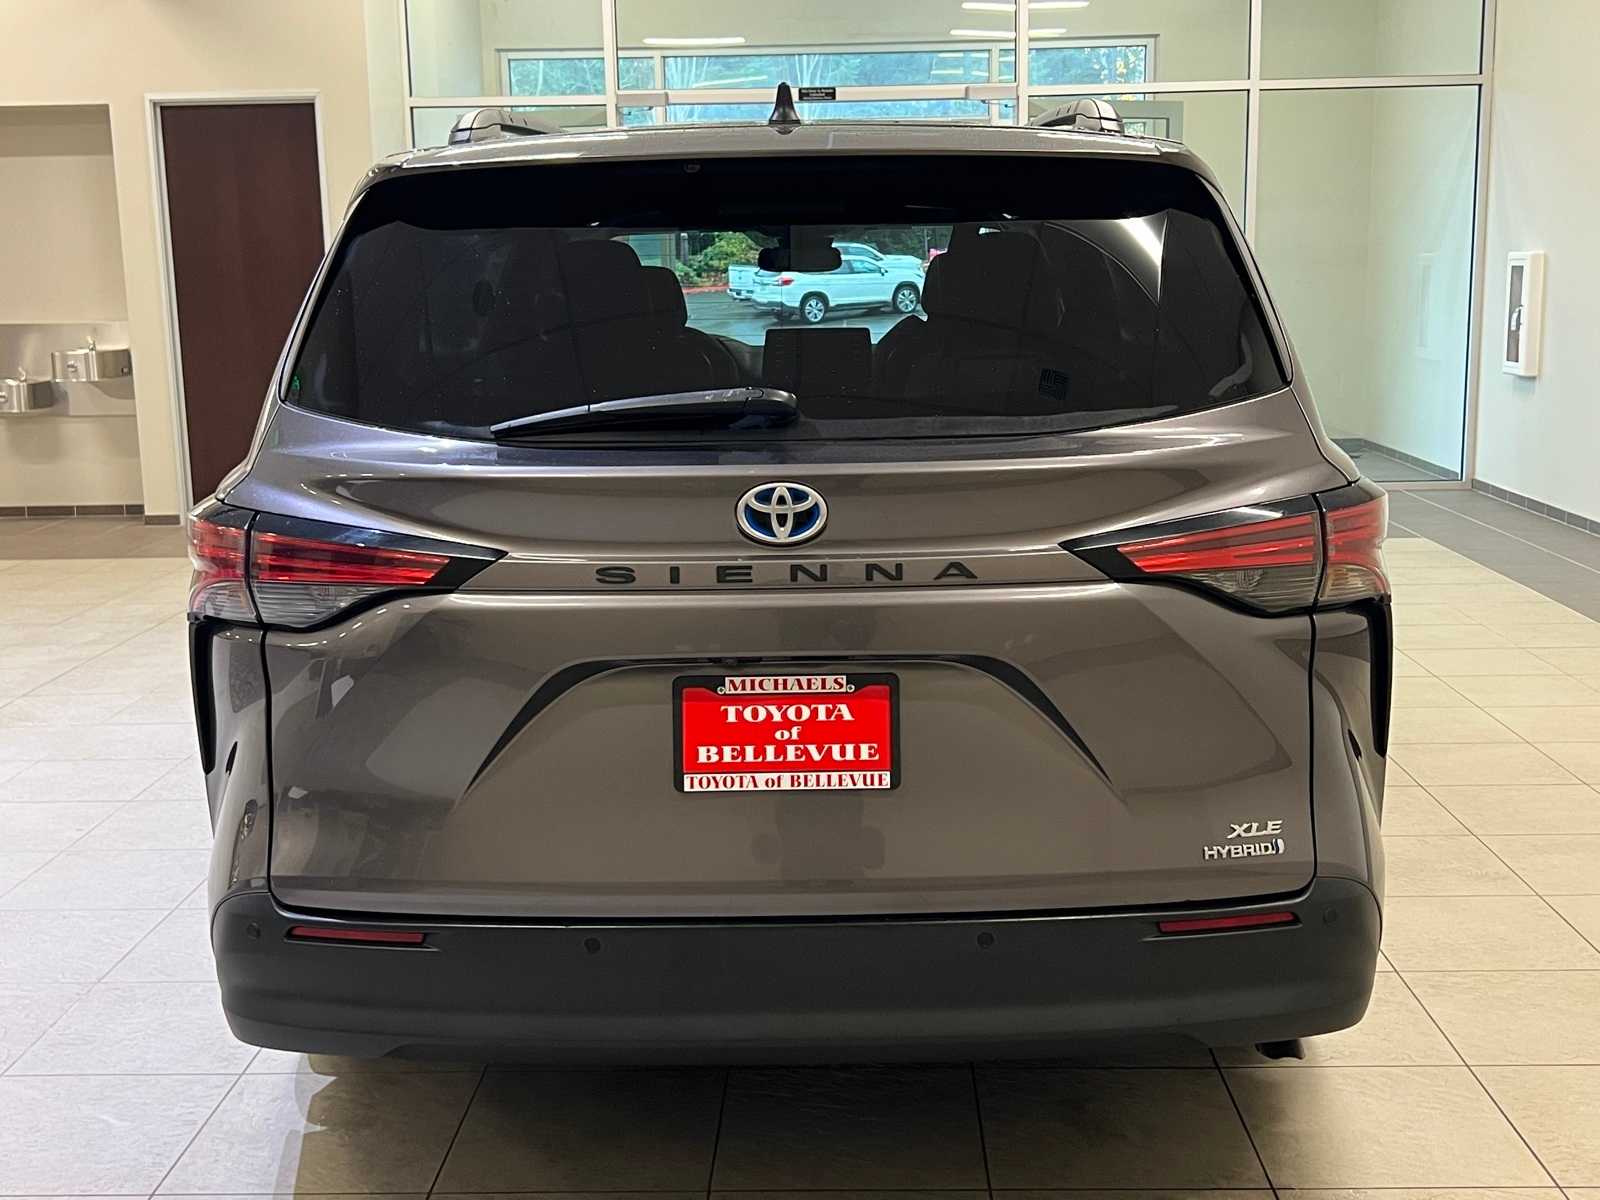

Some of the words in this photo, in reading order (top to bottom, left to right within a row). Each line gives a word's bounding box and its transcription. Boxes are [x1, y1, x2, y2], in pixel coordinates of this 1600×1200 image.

[595, 562, 978, 584] SIENNA
[727, 676, 845, 692] MICHAELS
[720, 703, 855, 722] TOYOTA
[774, 726, 802, 740] of
[697, 743, 880, 763] BELLEVUE
[686, 775, 759, 789] TOYOTA
[765, 774, 784, 788] of
[790, 773, 889, 788] BELLEVUE
[1226, 820, 1283, 839] XLE
[1204, 842, 1273, 860] HYBRID
